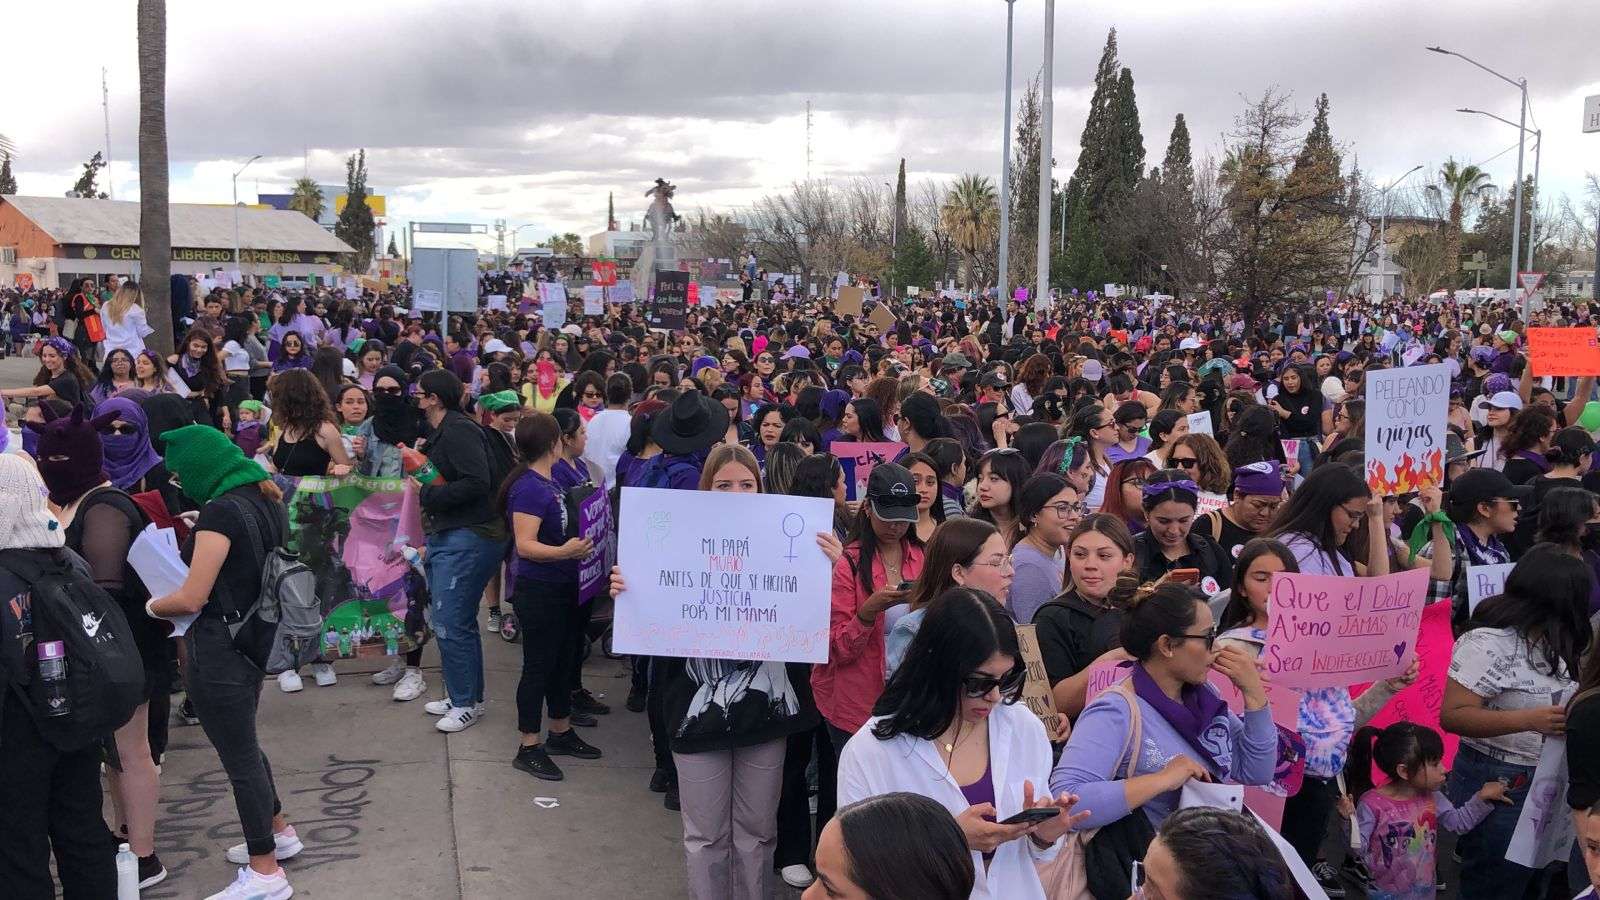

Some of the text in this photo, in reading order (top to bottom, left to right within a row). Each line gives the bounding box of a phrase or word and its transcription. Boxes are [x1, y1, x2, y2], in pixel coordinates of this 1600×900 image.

[111, 248, 140, 260] CEN
[173, 249, 231, 262] LIBRERO
[253, 250, 301, 263] PRENSA
[1376, 375, 1445, 400] PELEANDO
[1387, 397, 1426, 419] COMO
[1377, 421, 1433, 451] niñas
[702, 536, 750, 557] MI PAPÁ
[659, 569, 798, 593] ANTES DE QUE SE HICIERA
[1476, 573, 1496, 596] Por
[700, 589, 752, 606] JUSTICIA
[1275, 577, 1415, 611] Que el Dolor
[682, 603, 777, 623] POR MI MAMÁ
[1272, 614, 1331, 642] Ajeno
[1338, 614, 1389, 635] JAMAS
[1268, 644, 1392, 674] Sea INDIFERENTE
